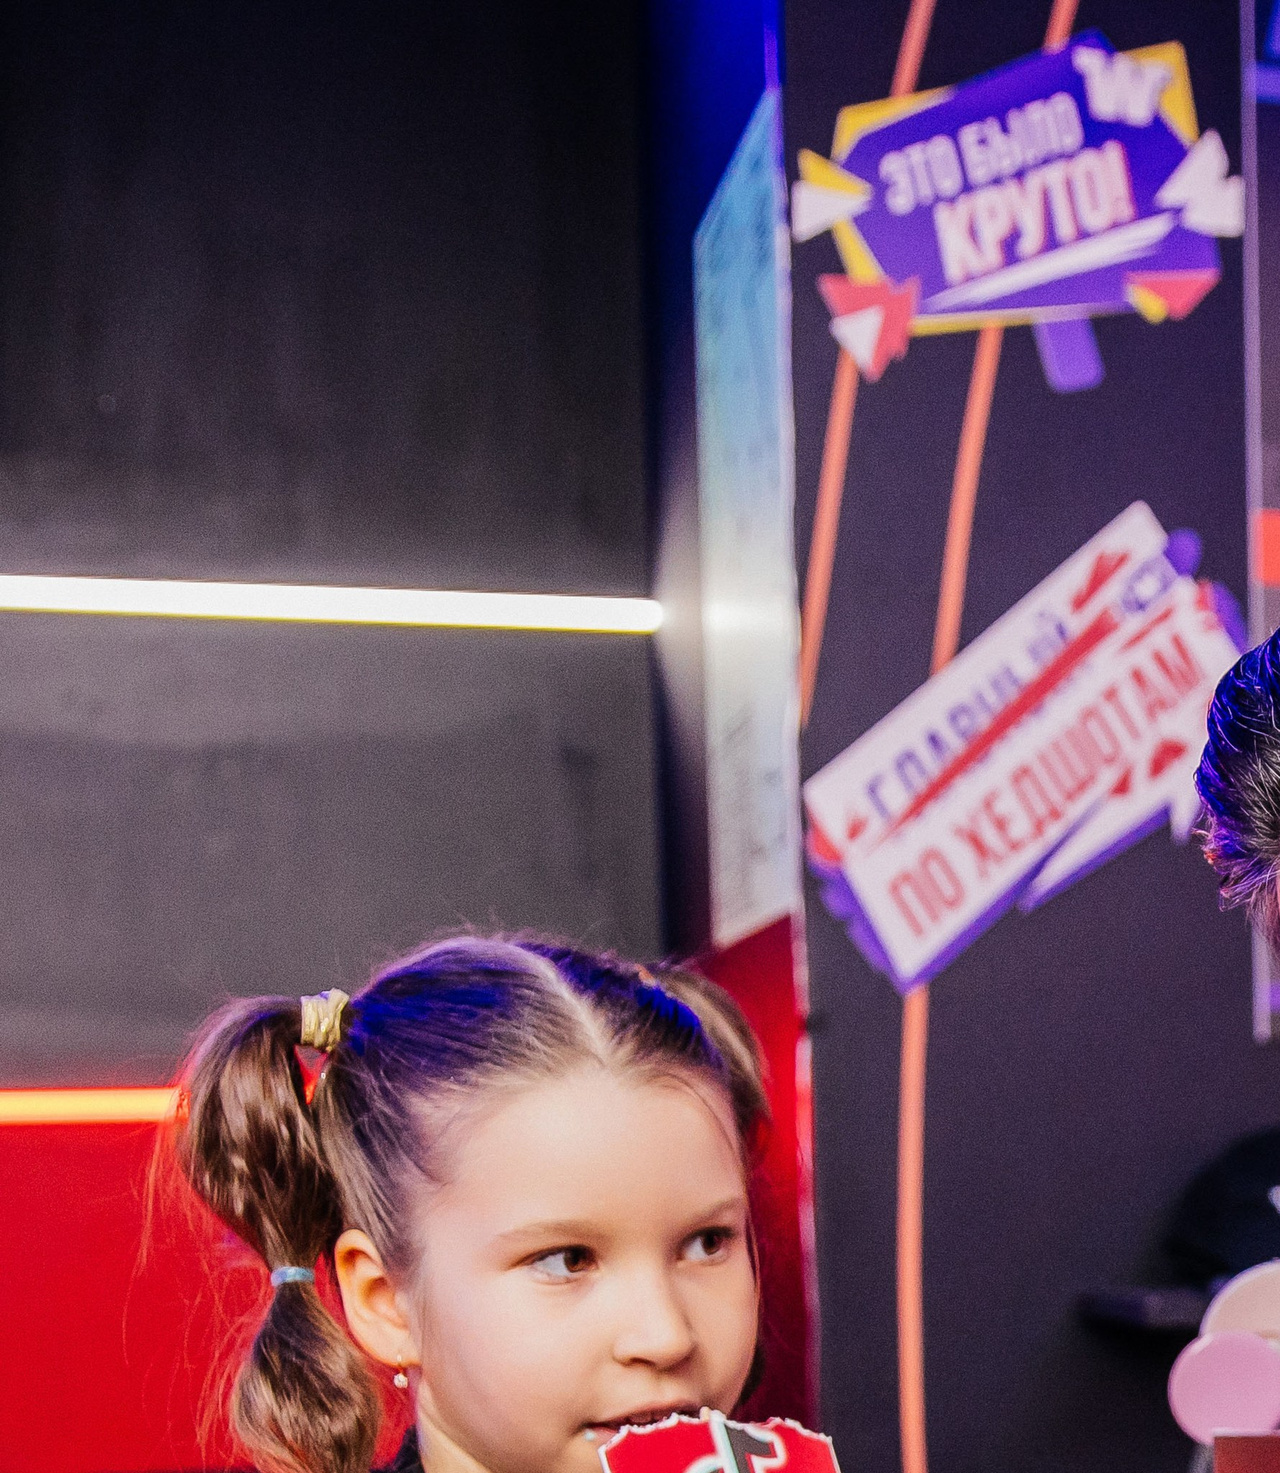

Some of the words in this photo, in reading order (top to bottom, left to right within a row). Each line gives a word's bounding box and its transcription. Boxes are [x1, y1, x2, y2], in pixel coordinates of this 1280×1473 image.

[878, 135, 962, 216] ЭТО
[958, 92, 1086, 186] БЫЛО
[933, 141, 1137, 285] КРУТО!
[888, 847, 967, 938] ПО
[954, 632, 1202, 878] ХЕДШОТАМ
